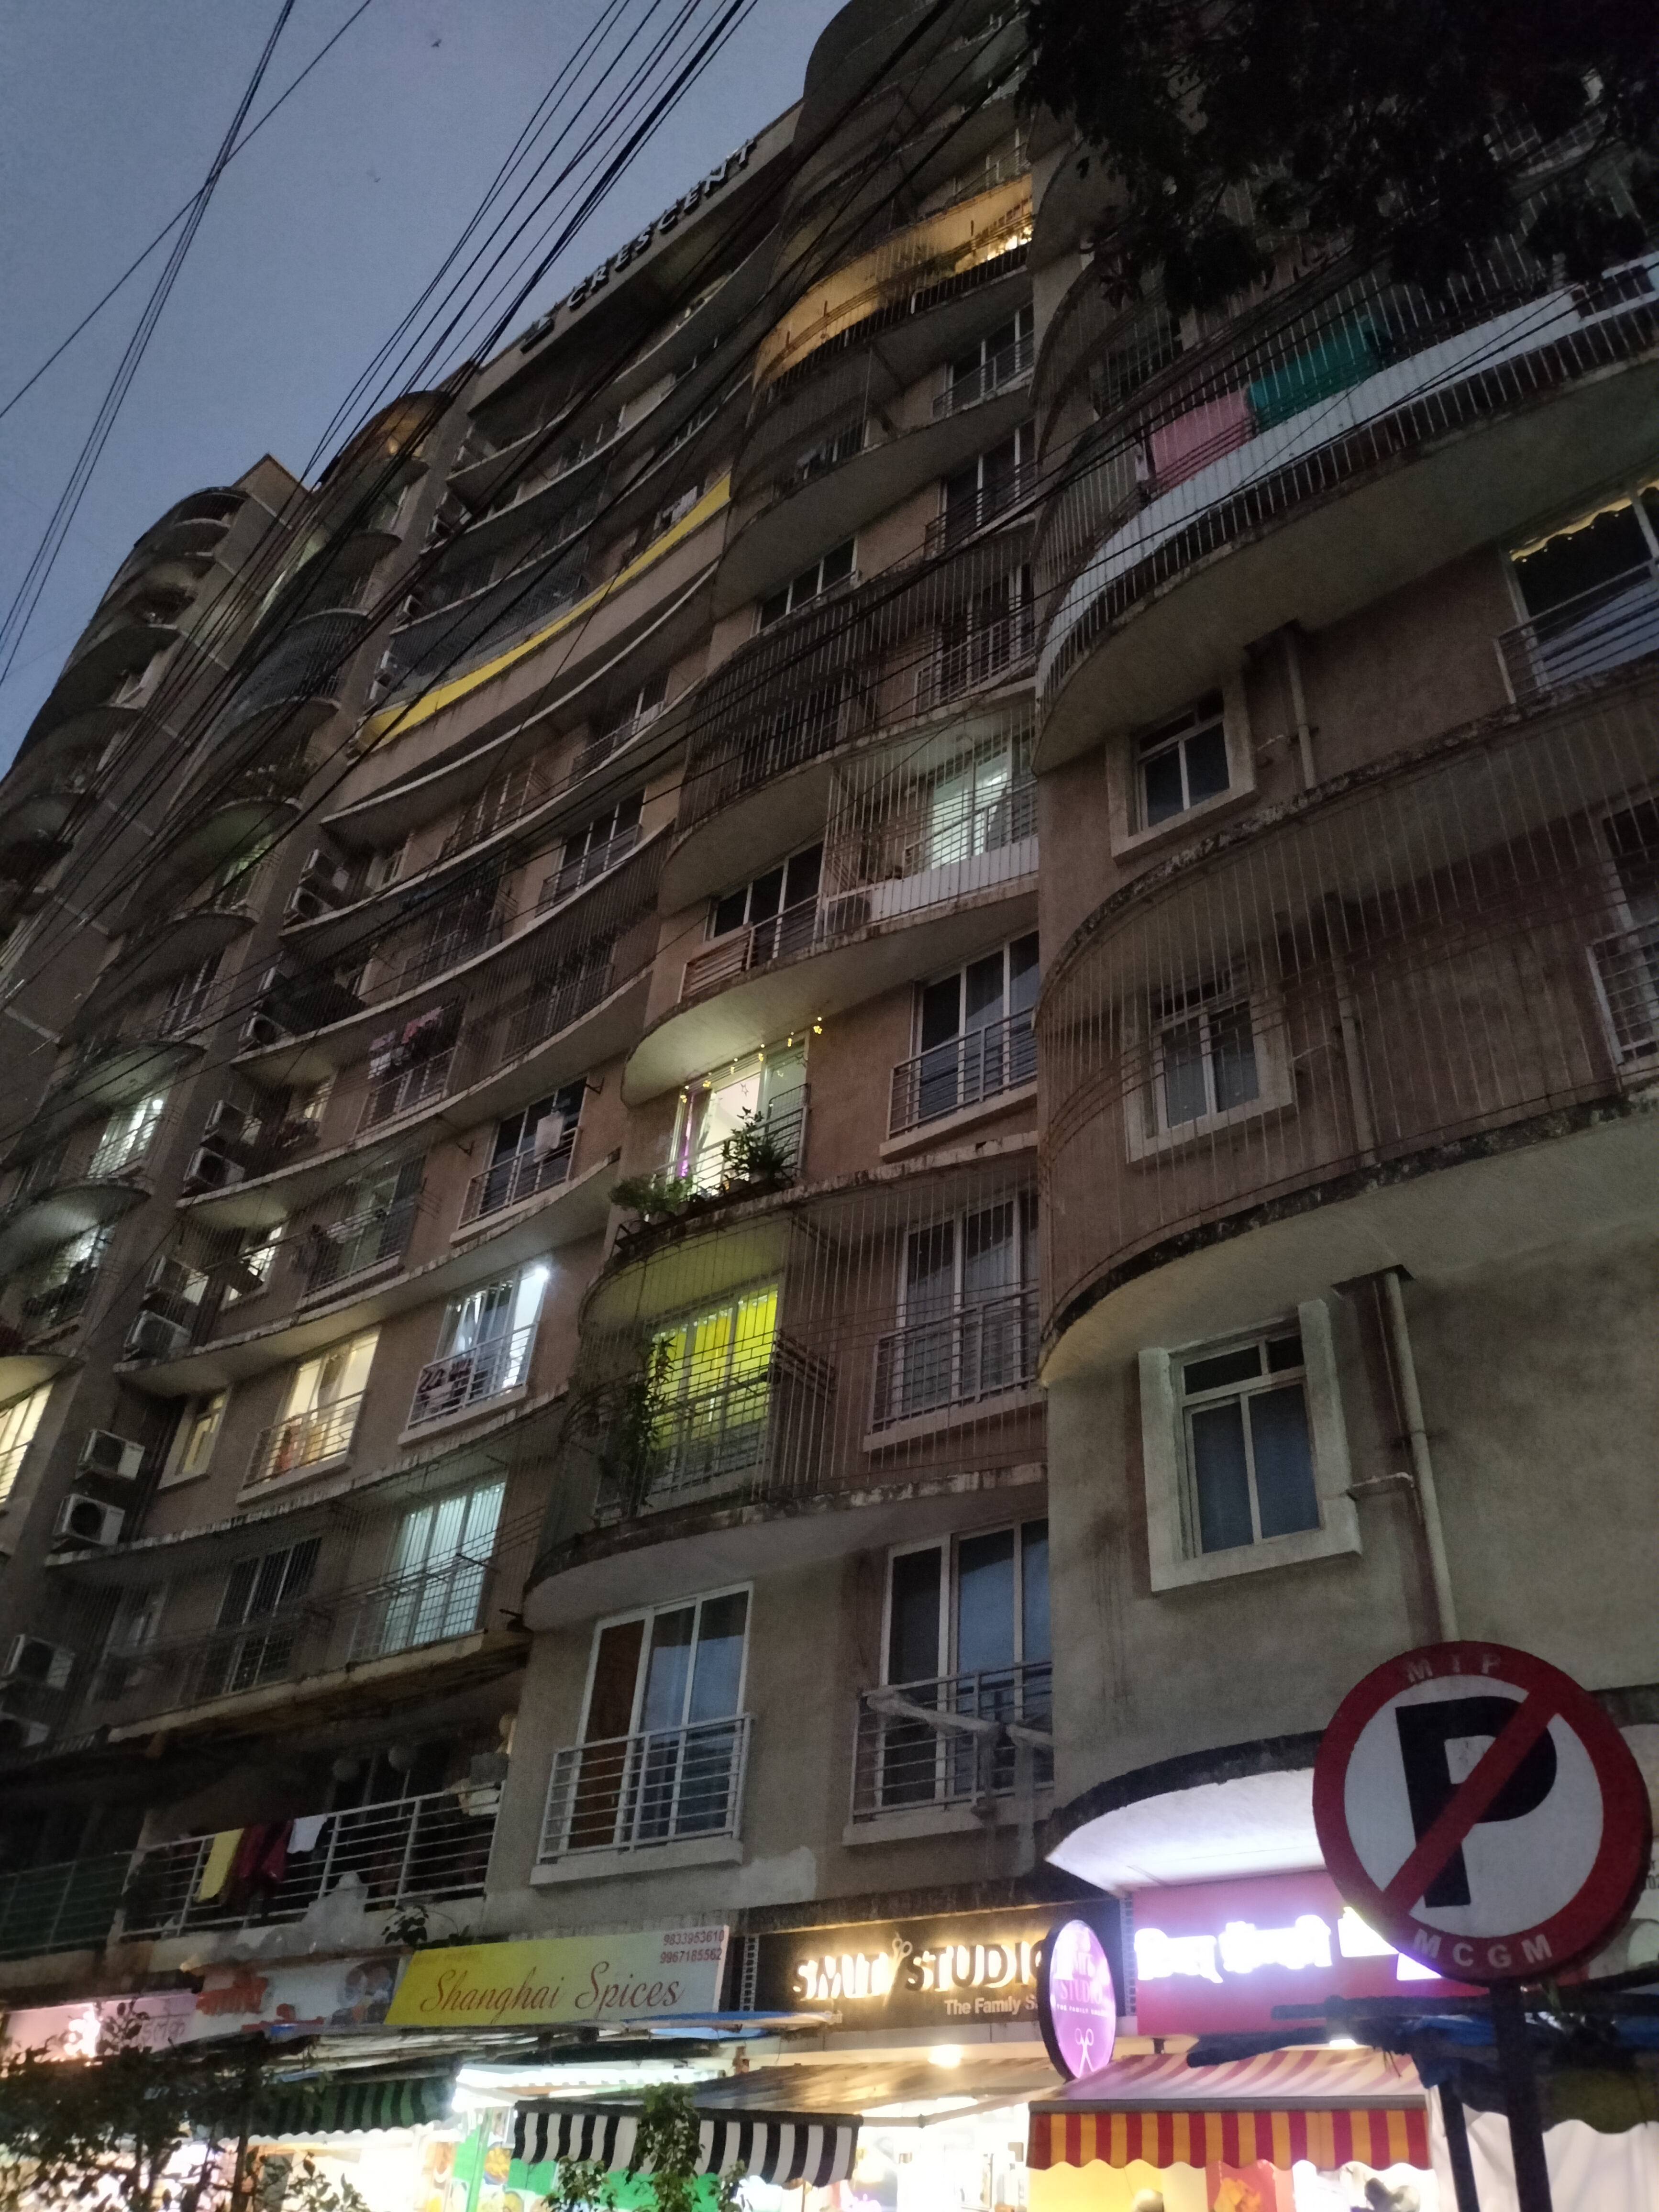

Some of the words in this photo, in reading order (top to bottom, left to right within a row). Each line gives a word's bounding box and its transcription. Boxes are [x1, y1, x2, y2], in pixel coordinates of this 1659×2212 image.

[566, 138, 756, 310] CRESCENT
[1413, 1928, 1553, 1969] MCGM
[420, 1966, 564, 2024] Shanghai
[575, 1961, 687, 2021] Spices
[944, 1998, 971, 2015] The
[974, 1996, 1021, 2016] Family
